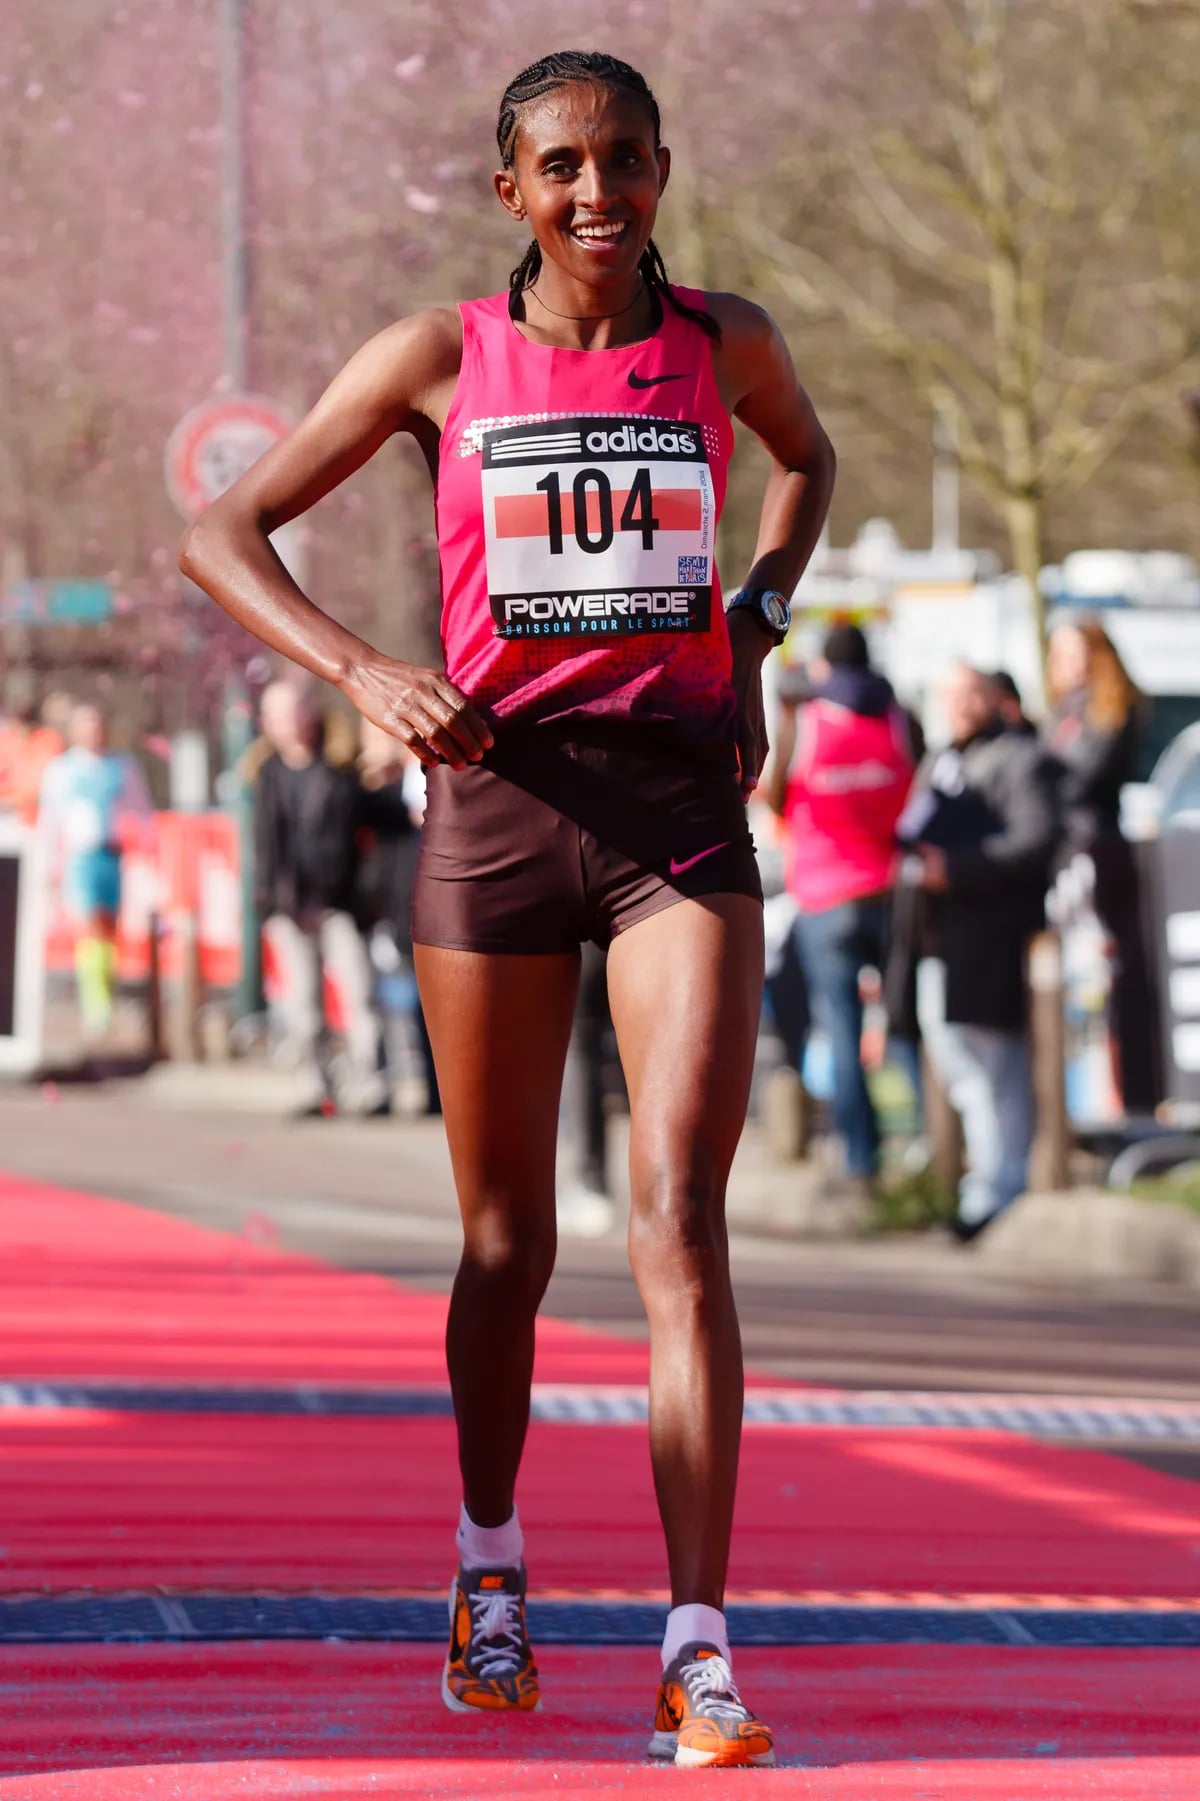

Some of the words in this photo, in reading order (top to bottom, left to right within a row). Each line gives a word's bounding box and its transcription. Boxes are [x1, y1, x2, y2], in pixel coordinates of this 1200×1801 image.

[586, 426, 697, 454] adidas
[536, 468, 659, 555] 104
[701, 514, 709, 549] Dimanche
[505, 621, 571, 636] BOISSON
[580, 619, 618, 632] POUR
[628, 618, 643, 629] LE
[651, 616, 691, 629] SPORT
